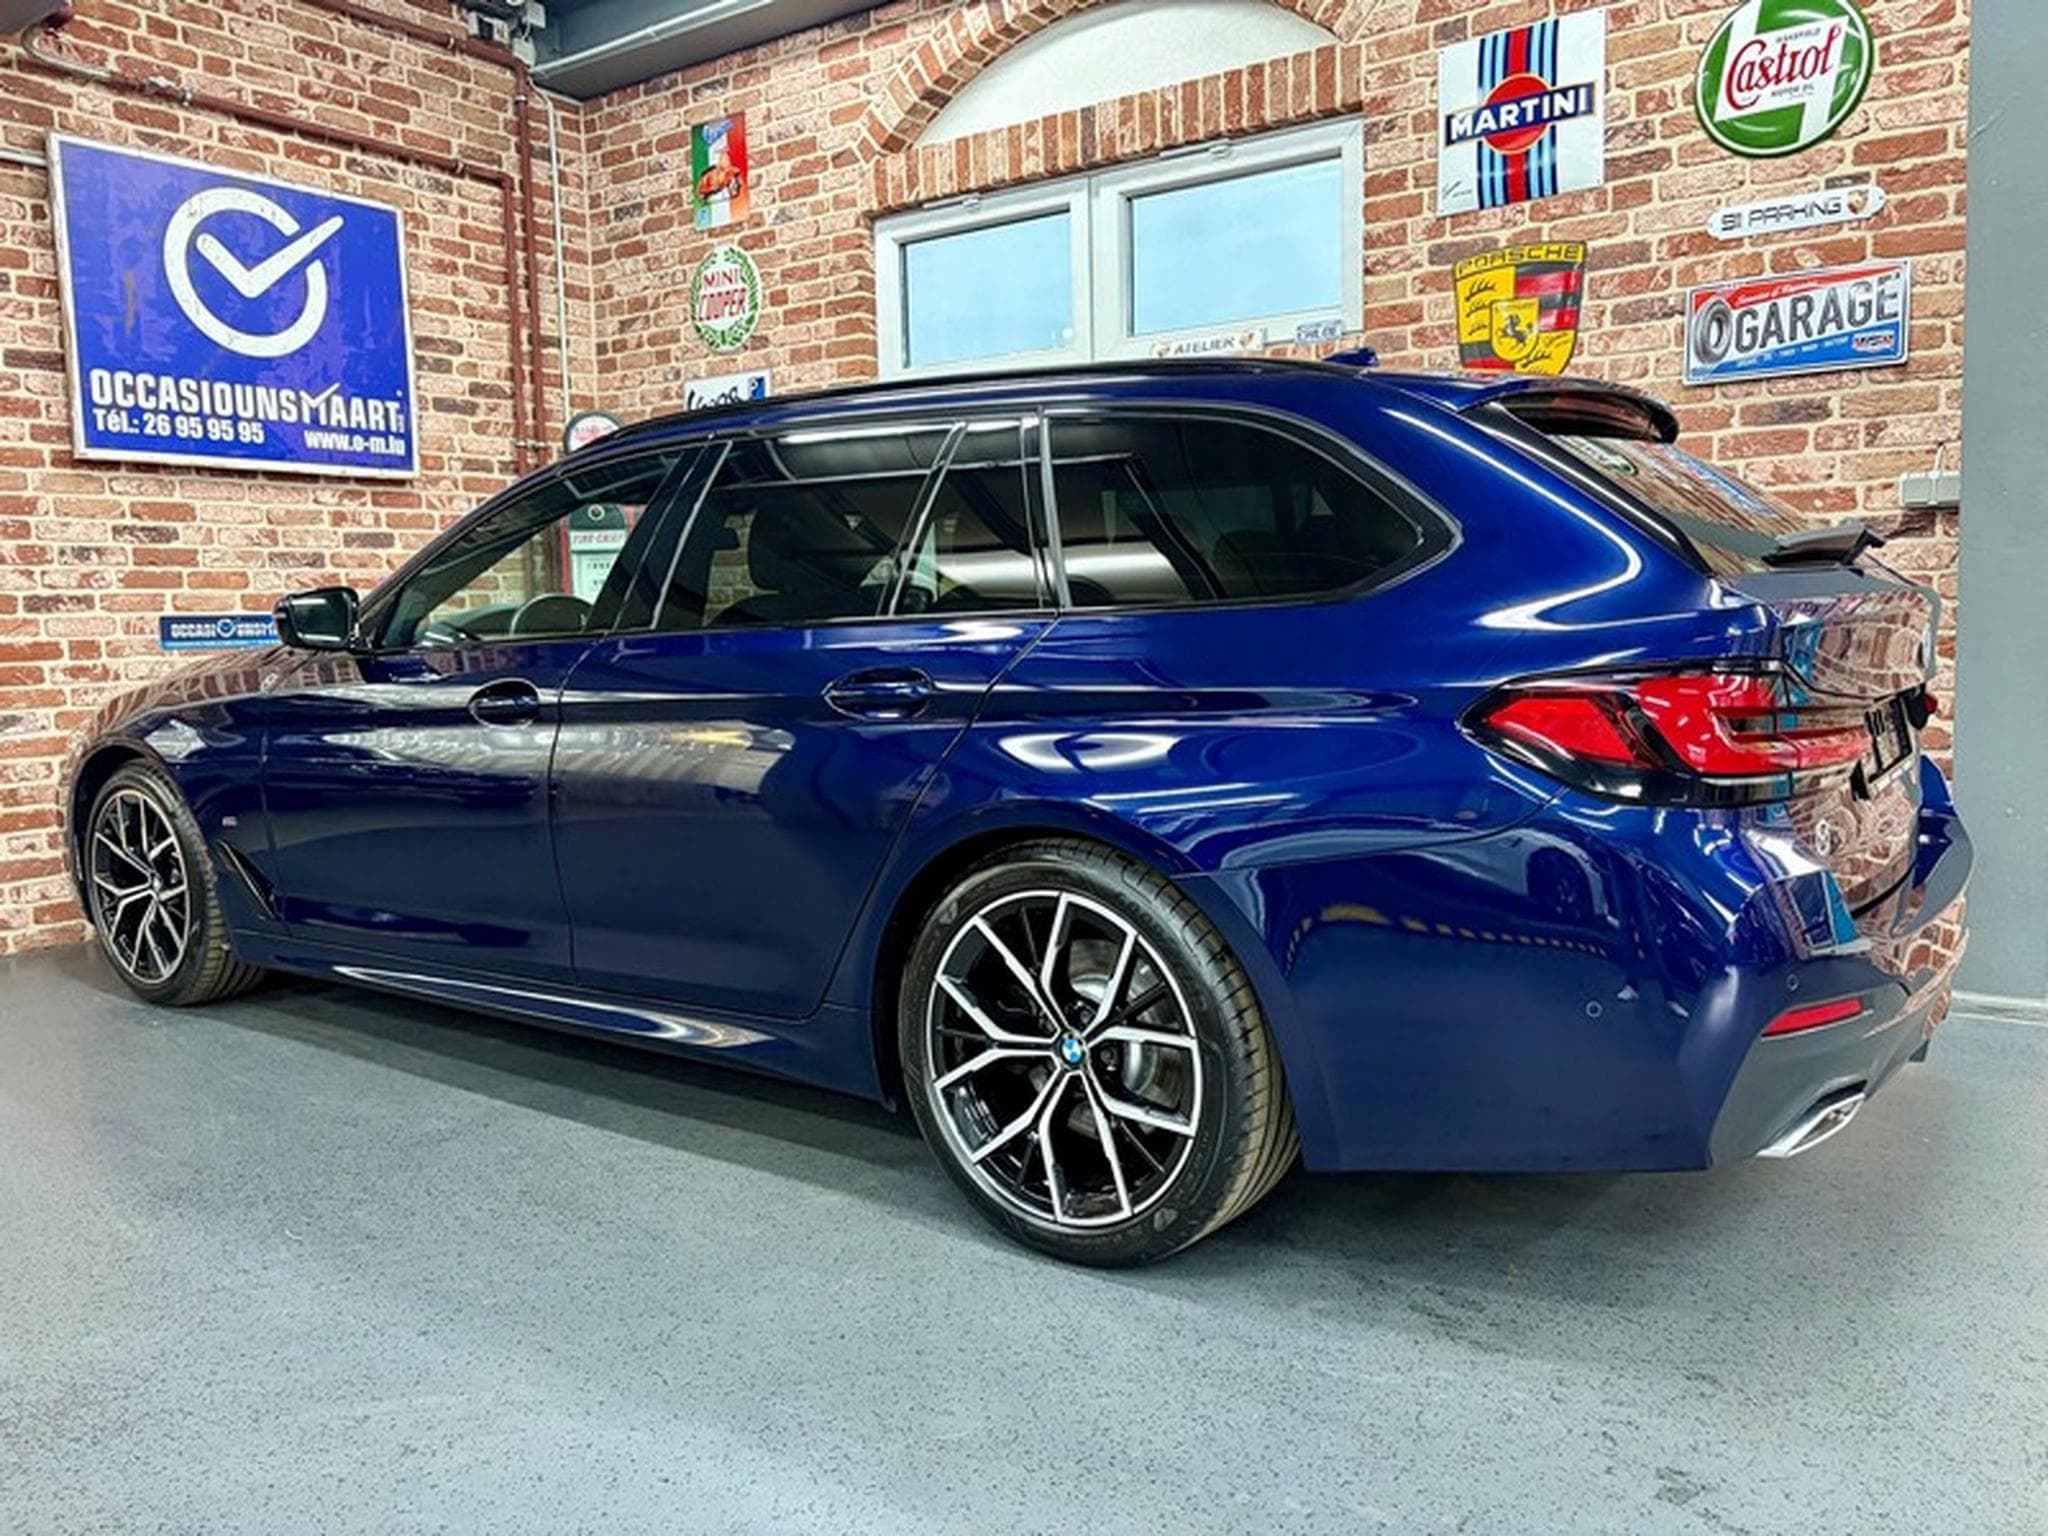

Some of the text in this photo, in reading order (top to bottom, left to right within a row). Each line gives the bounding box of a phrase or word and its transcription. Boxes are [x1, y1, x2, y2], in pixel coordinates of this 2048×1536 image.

[1725, 22, 1842, 111] Castrol
[1451, 87, 1587, 140] MARTINI
[1748, 197, 1842, 226] PARKING
[1455, 246, 1580, 276] PORSCHE
[703, 267, 740, 291] MINI
[1734, 271, 1901, 355] GARAGE
[89, 367, 401, 433] OCCASIOUNSMAART
[142, 411, 172, 437] 26
[174, 414, 204, 440] 95
[206, 417, 235, 443] 95
[237, 419, 266, 445] 95
[303, 429, 406, 456] www.o-m.lu
